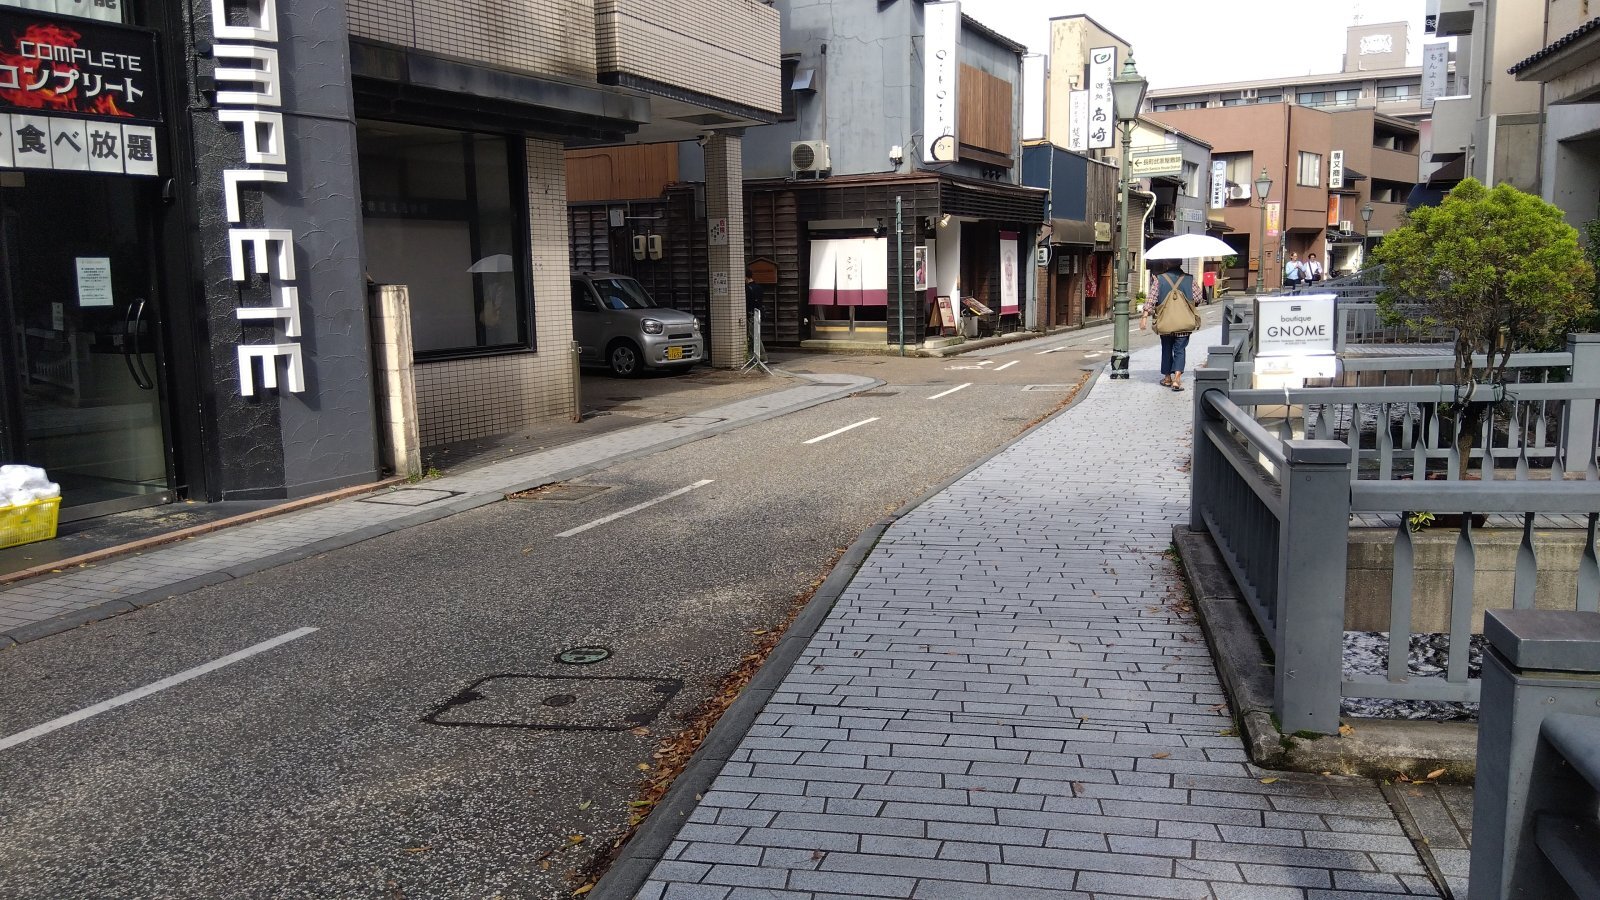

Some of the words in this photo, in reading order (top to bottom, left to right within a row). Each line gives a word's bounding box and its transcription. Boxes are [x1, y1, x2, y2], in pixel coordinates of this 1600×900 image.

[20, 40, 142, 72] COMPLETE
[0, 64, 144, 103] コンプリート
[16, 123, 155, 162] 食べ放題
[1267, 325, 1326, 338] GNOME
[1280, 315, 1312, 324] boutique
